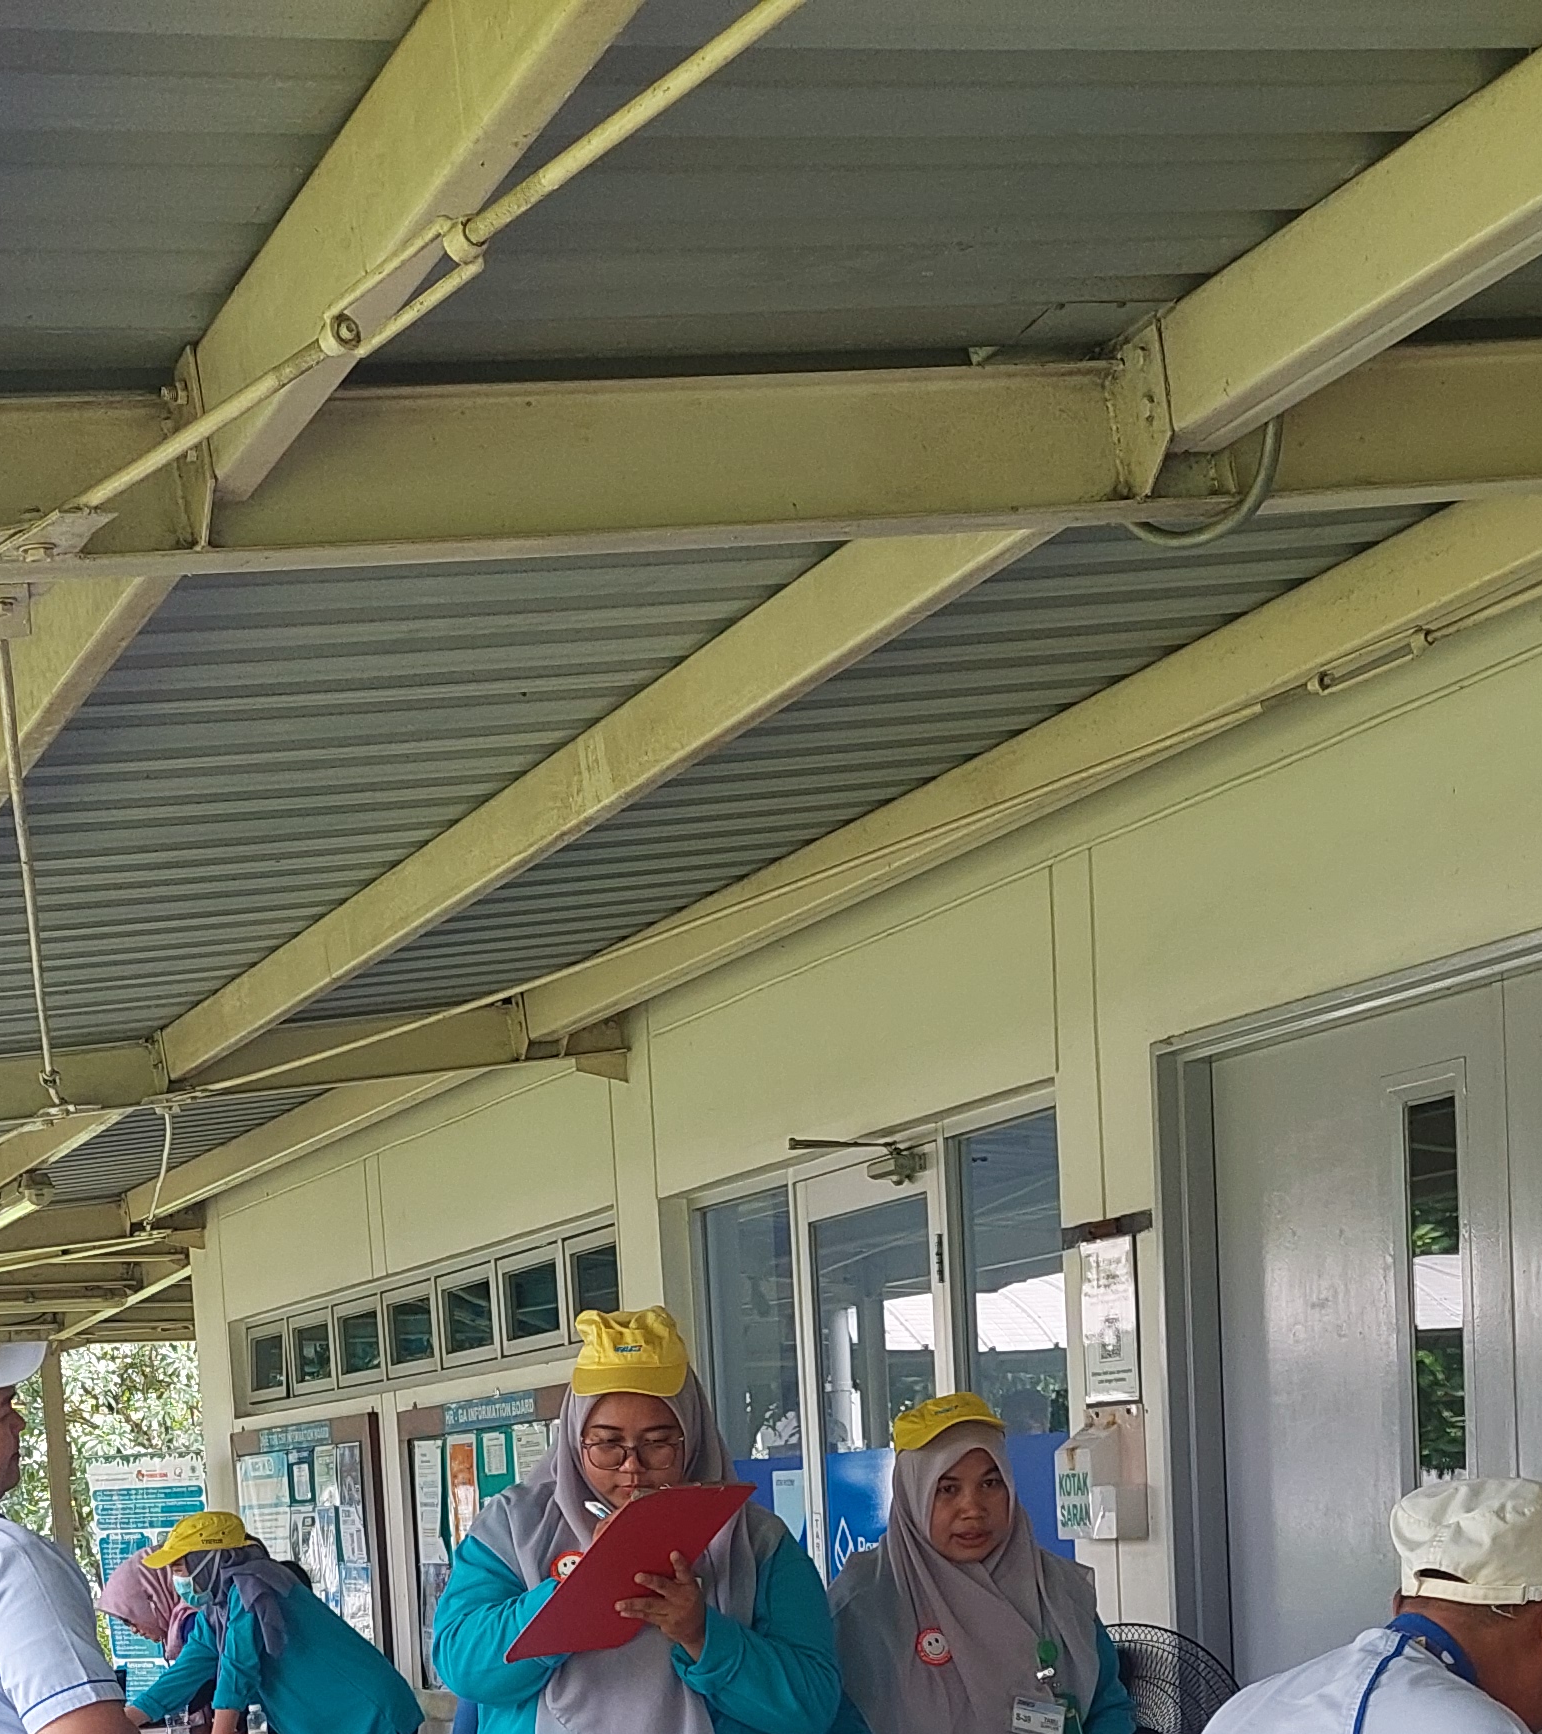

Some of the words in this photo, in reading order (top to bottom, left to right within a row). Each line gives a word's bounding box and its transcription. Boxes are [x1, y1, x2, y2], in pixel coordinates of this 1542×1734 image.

[445, 1410, 455, 1425] HR
[459, 1408, 468, 1423] GA
[468, 1402, 511, 1421] INFORMATION
[511, 1398, 534, 1416] BOARD
[1059, 1471, 1089, 1497] KOTAK
[1060, 1502, 1092, 1528] SARAN
